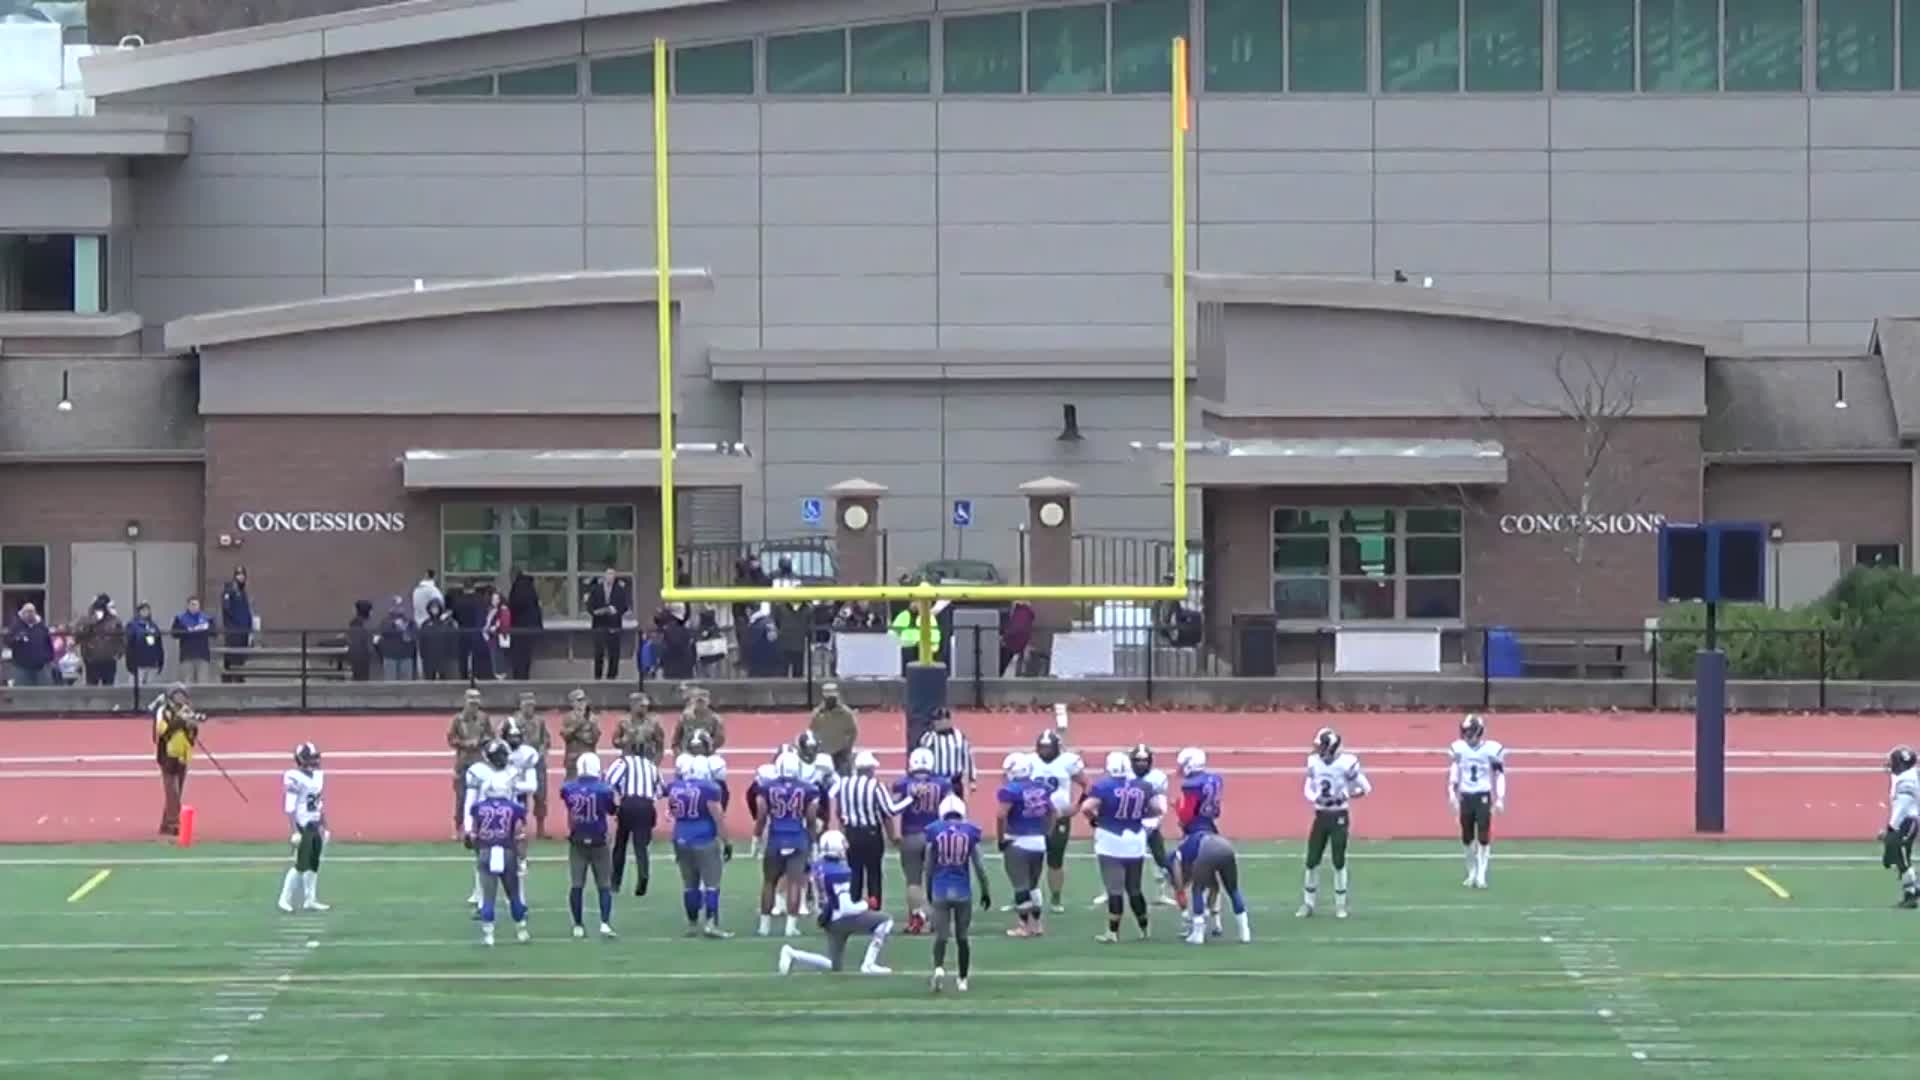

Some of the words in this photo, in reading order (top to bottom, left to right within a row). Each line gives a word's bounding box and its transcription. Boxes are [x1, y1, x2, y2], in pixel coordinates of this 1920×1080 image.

[238, 511, 405, 532] CONCESSIONS
[569, 793, 599, 823] 21
[769, 786, 805, 819] 54
[1114, 788, 1144, 819] 77
[478, 805, 513, 840] 23
[936, 832, 968, 865] 10
